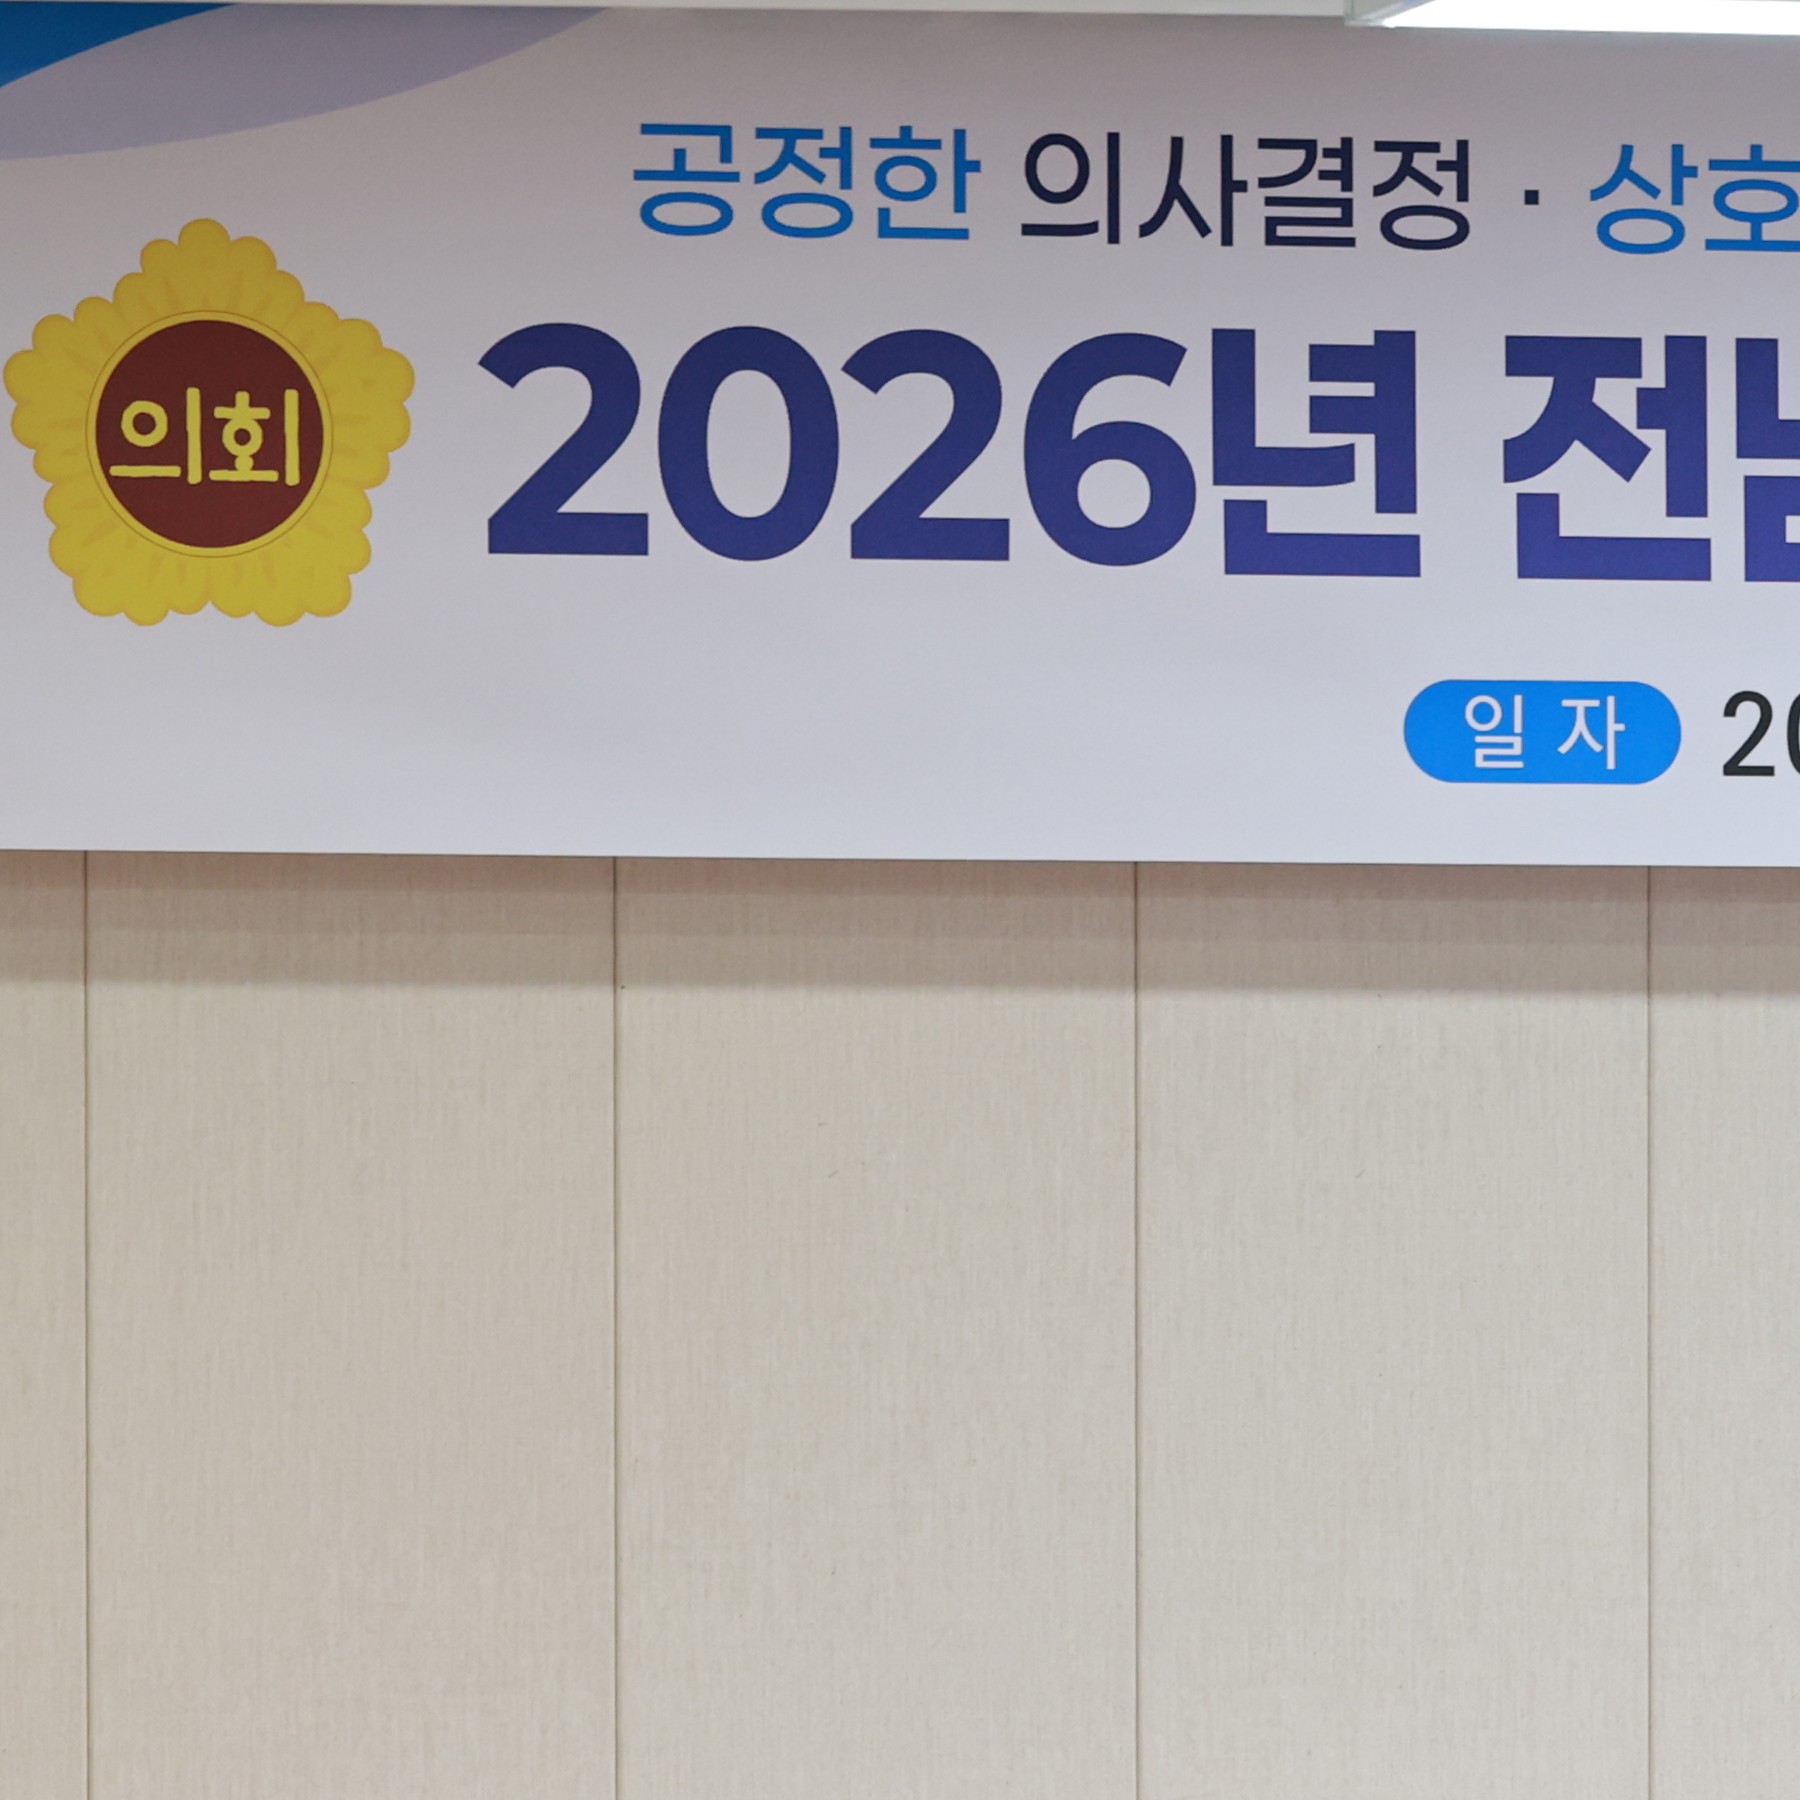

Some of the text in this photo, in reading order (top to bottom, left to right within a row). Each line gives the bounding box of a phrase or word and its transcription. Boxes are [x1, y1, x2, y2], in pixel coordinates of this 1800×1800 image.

[634, 123, 981, 240] 공정한
[1022, 132, 1469, 250] 의사결정
[109, 388, 302, 490] 의회
[478, 323, 1420, 577] 2026년
